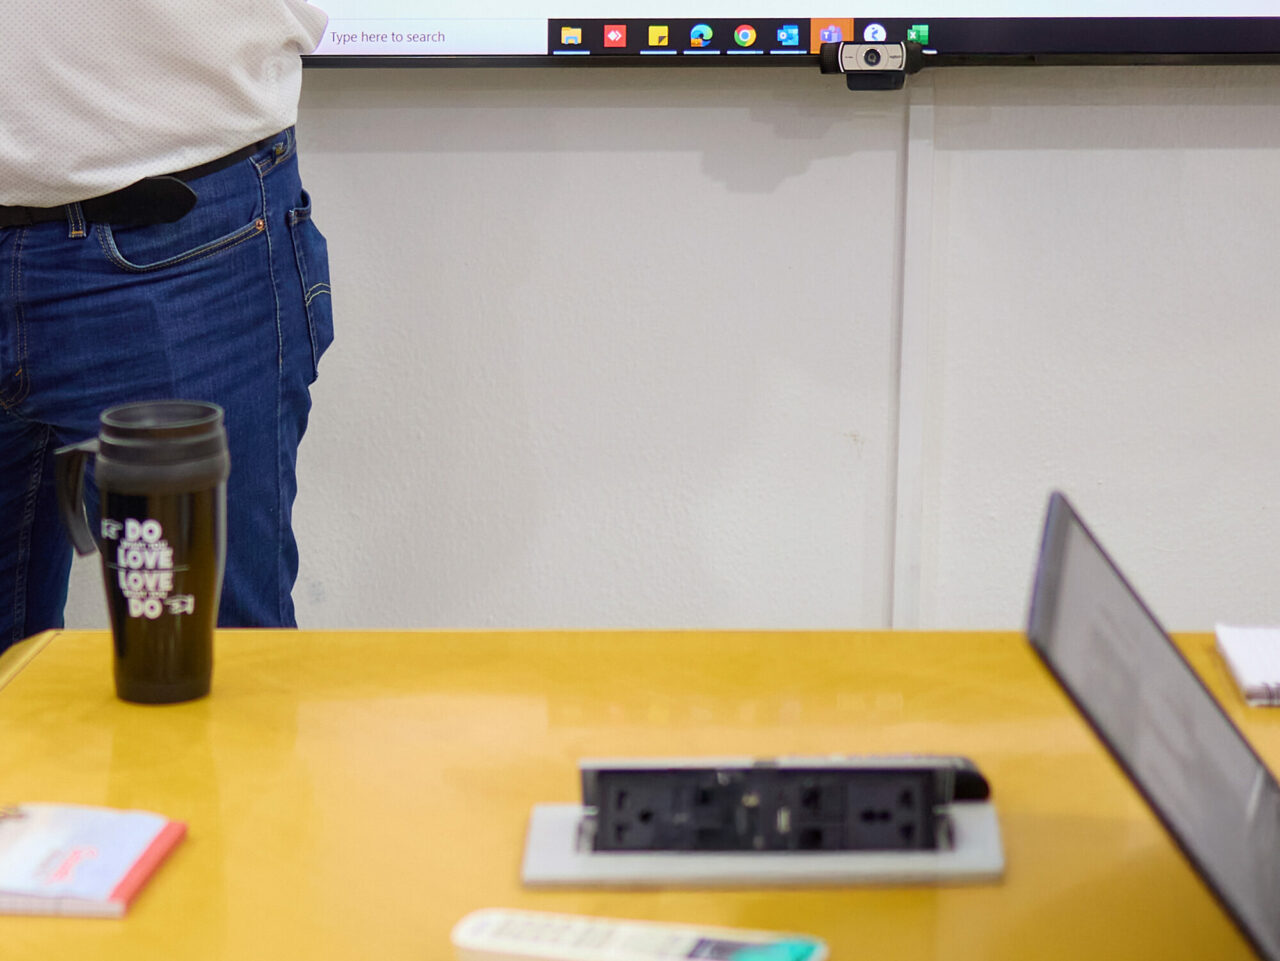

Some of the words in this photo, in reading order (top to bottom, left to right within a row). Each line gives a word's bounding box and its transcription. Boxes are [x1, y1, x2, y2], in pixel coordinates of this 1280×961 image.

[330, 31, 358, 45] Type
[361, 31, 388, 43] here
[391, 31, 404, 43] to
[406, 31, 446, 43] search
[124, 518, 163, 544] DO
[117, 546, 173, 570] LOVE
[118, 570, 173, 592] LOVE
[128, 597, 163, 619] DO
